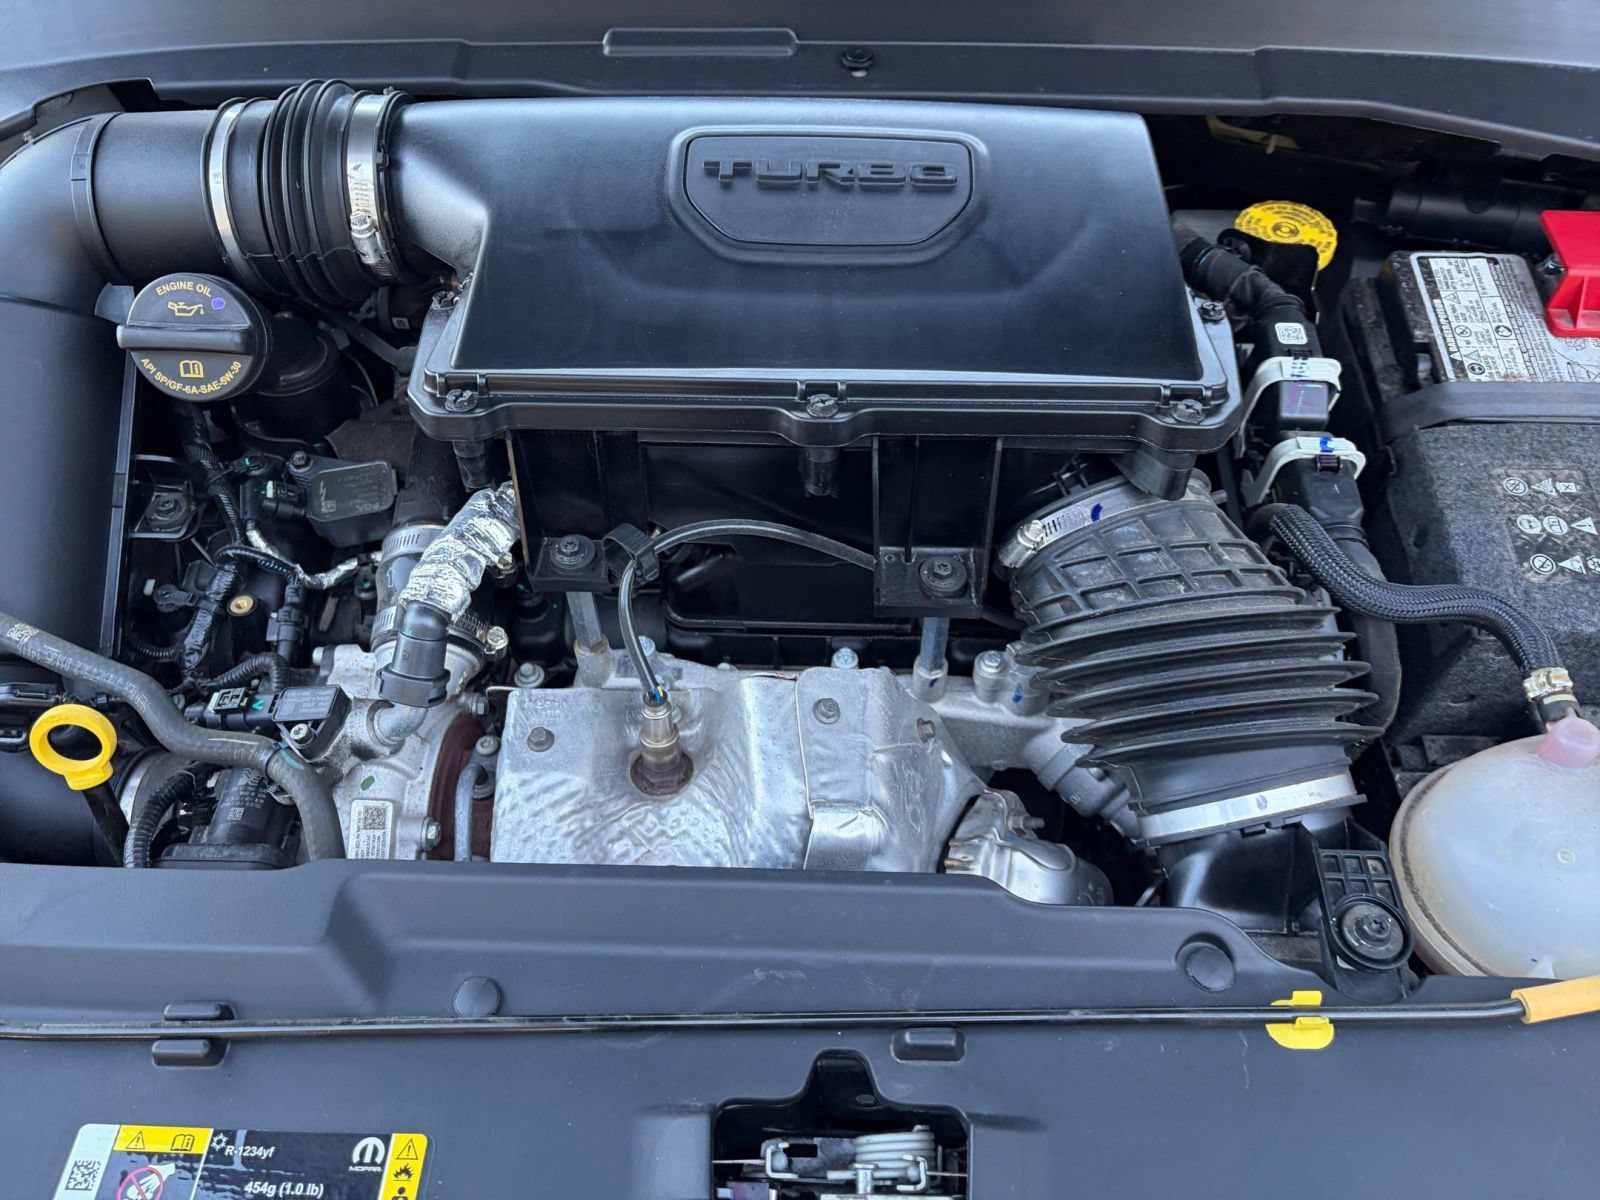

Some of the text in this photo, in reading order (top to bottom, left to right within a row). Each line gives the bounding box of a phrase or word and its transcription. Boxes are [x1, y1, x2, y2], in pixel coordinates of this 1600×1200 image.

[703, 159, 958, 187] TURBO
[155, 280, 212, 298] ENGINE OIL
[141, 358, 242, 395] API SP/GF-6A-SAE-5W-30
[225, 1146, 275, 1159] R-1234yf
[244, 1181, 324, 1199] 454g (1.0 lb)
